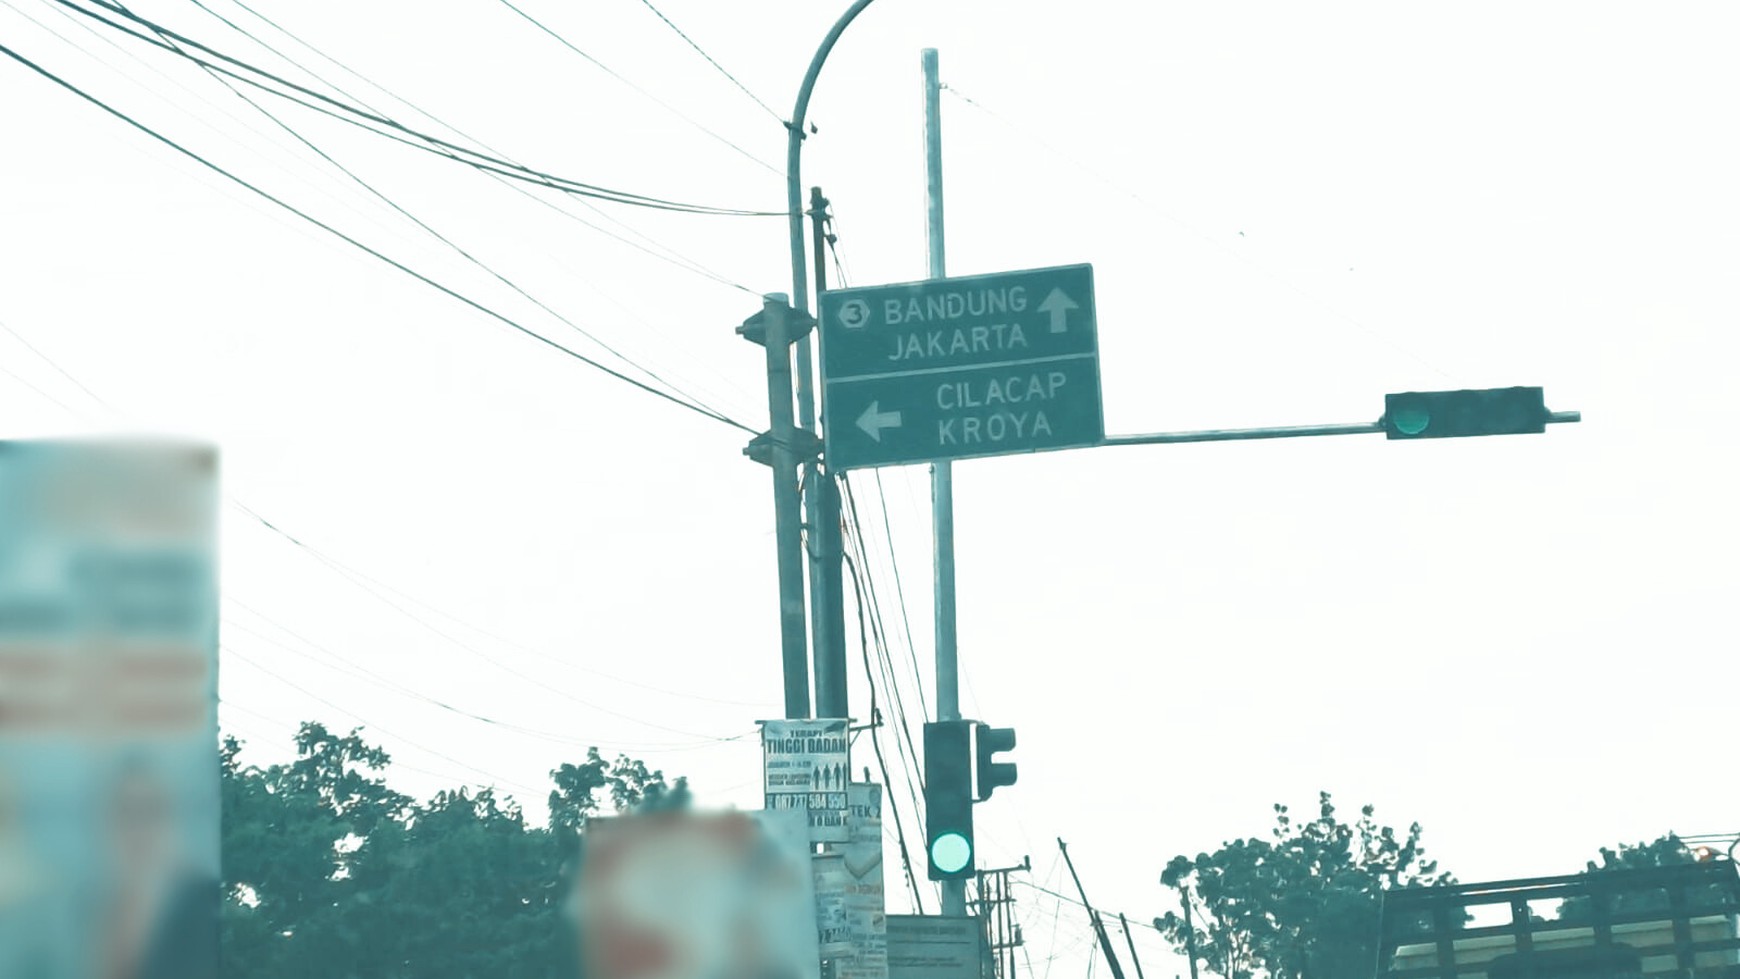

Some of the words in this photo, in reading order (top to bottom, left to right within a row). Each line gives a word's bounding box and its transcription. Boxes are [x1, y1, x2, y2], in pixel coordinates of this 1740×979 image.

[846, 304, 863, 324] 3
[885, 286, 1027, 325] BANDUNG
[889, 323, 1028, 361] JAKARTA
[937, 372, 1067, 409] CILACAP
[938, 411, 1051, 445] KROYA
[767, 738, 805, 754] TINGGI
[808, 738, 846, 754] BADAN
